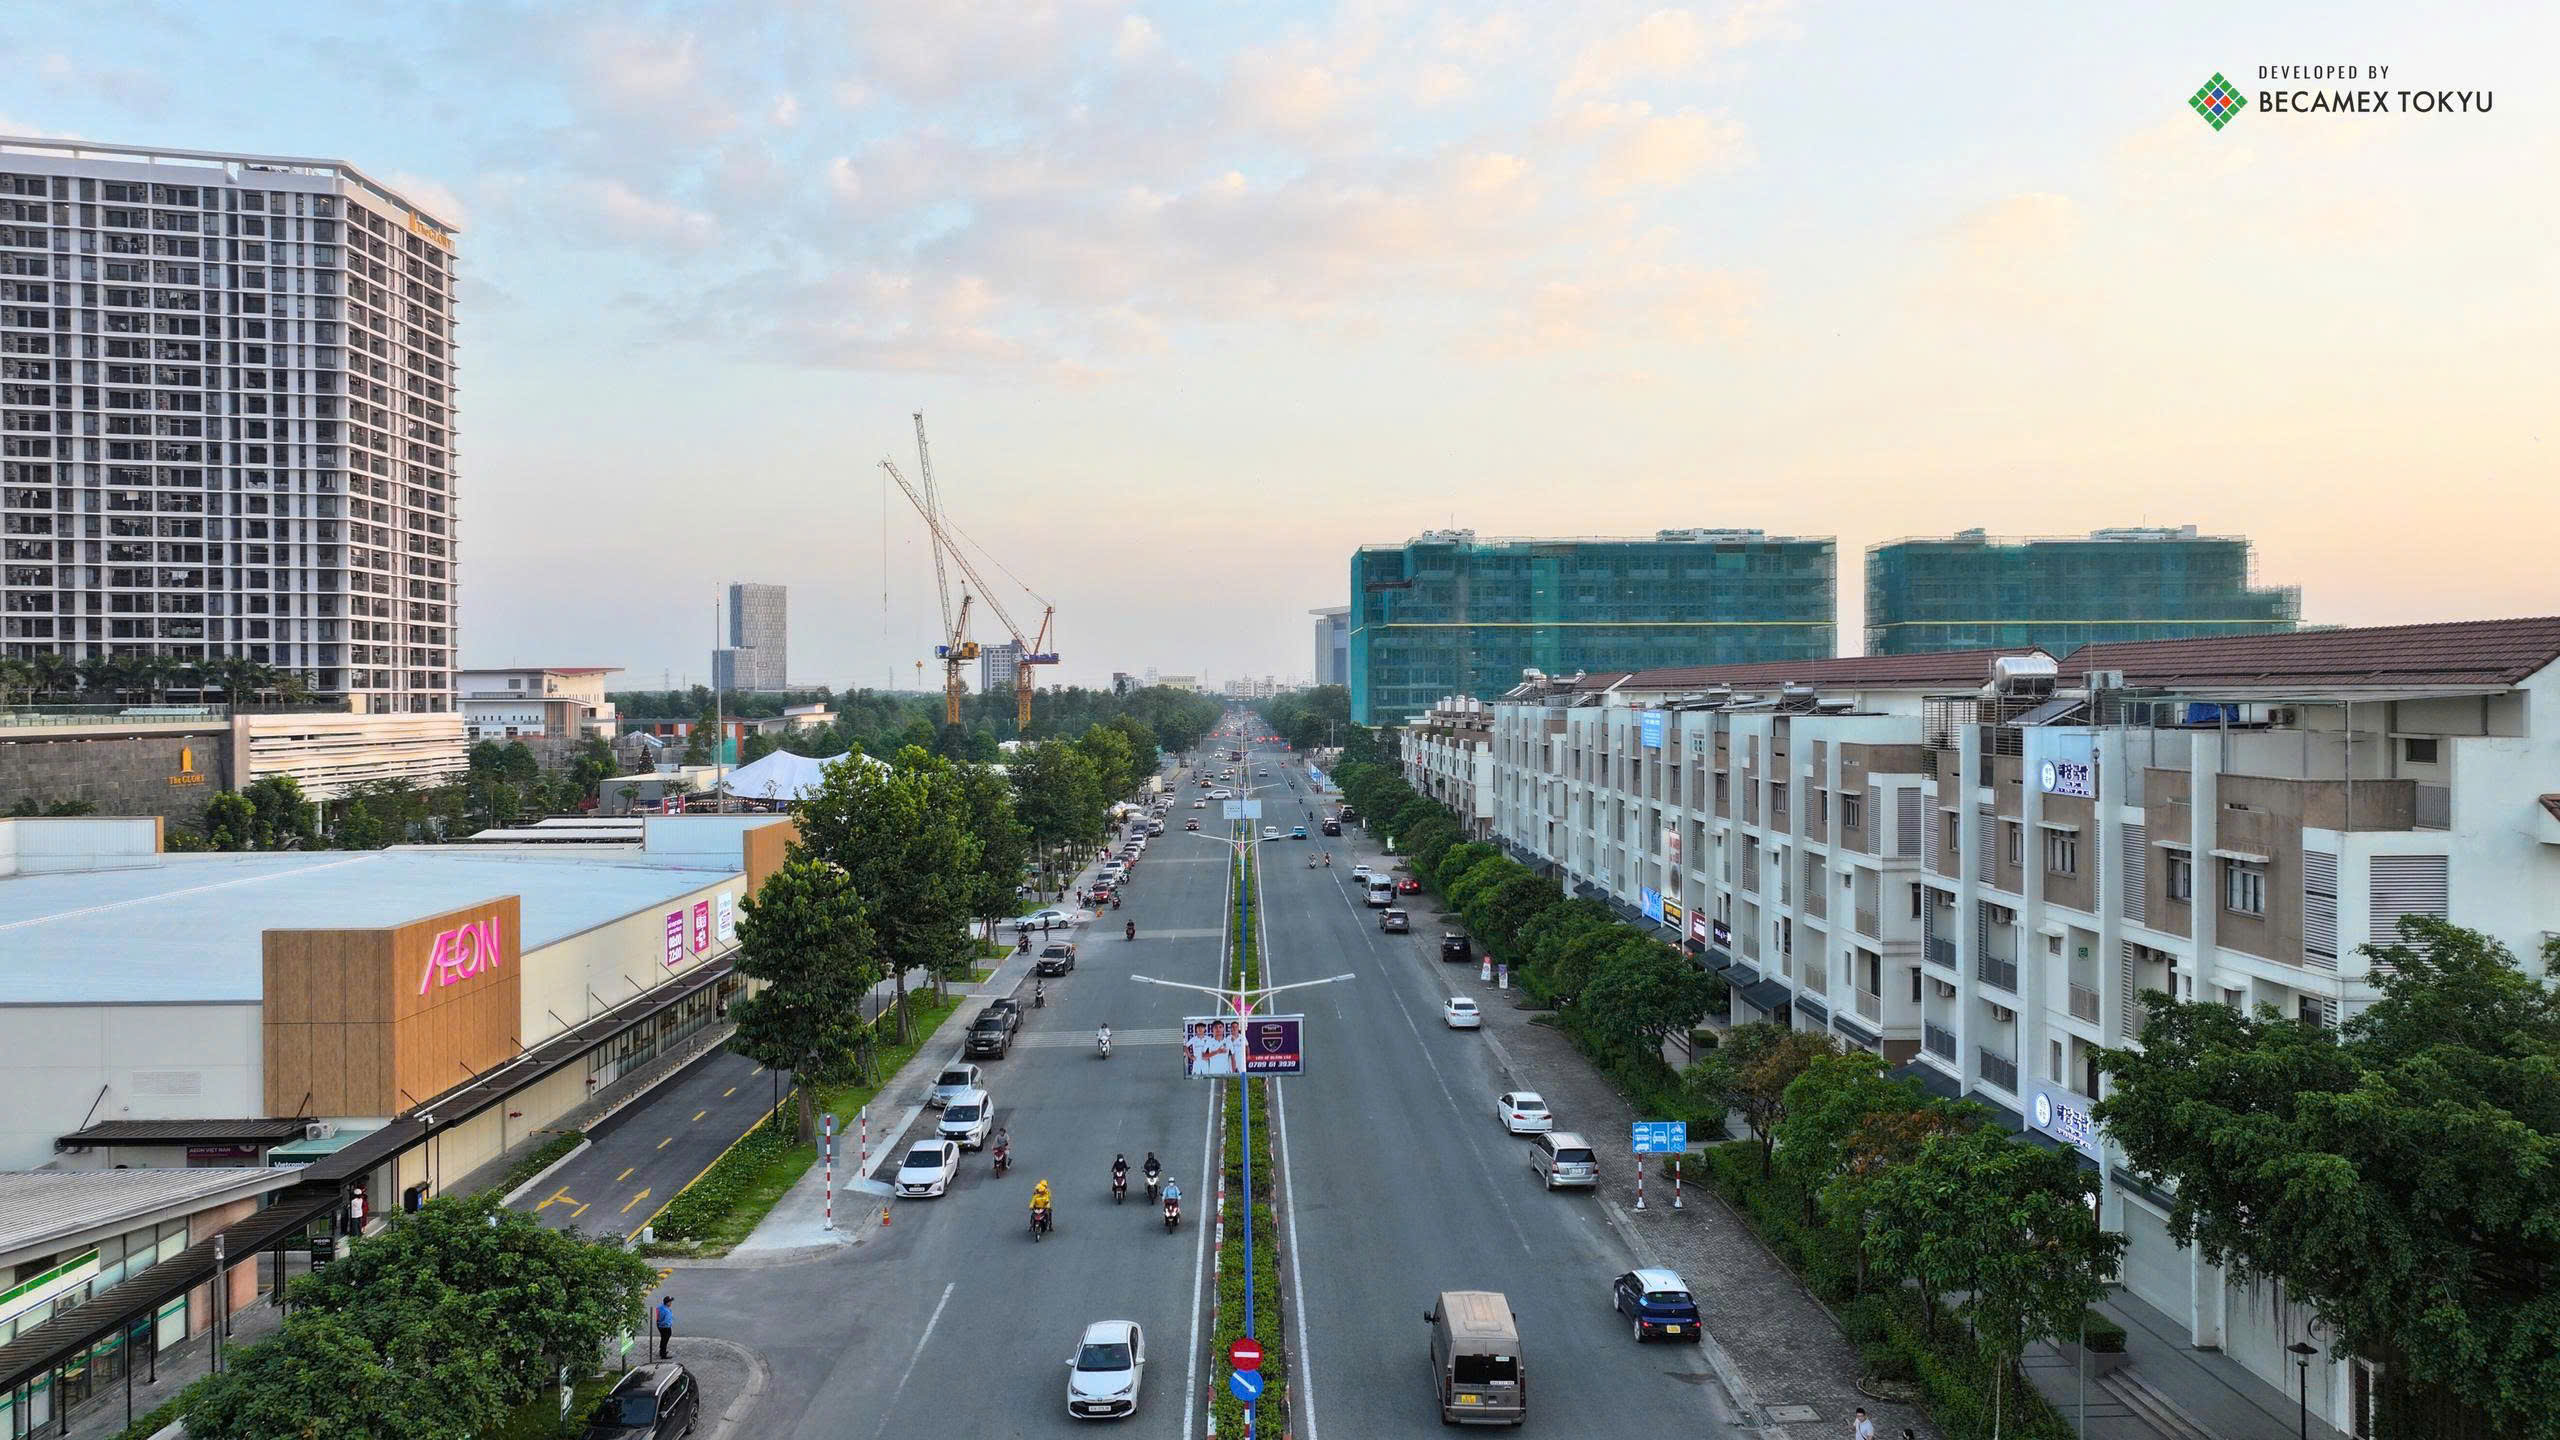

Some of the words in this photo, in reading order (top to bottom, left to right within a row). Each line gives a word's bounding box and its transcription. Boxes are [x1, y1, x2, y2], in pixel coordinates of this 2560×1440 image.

[182, 774, 205, 784] GLORY
[419, 915, 501, 996] AEON
[668, 946, 682, 963] 22:00
